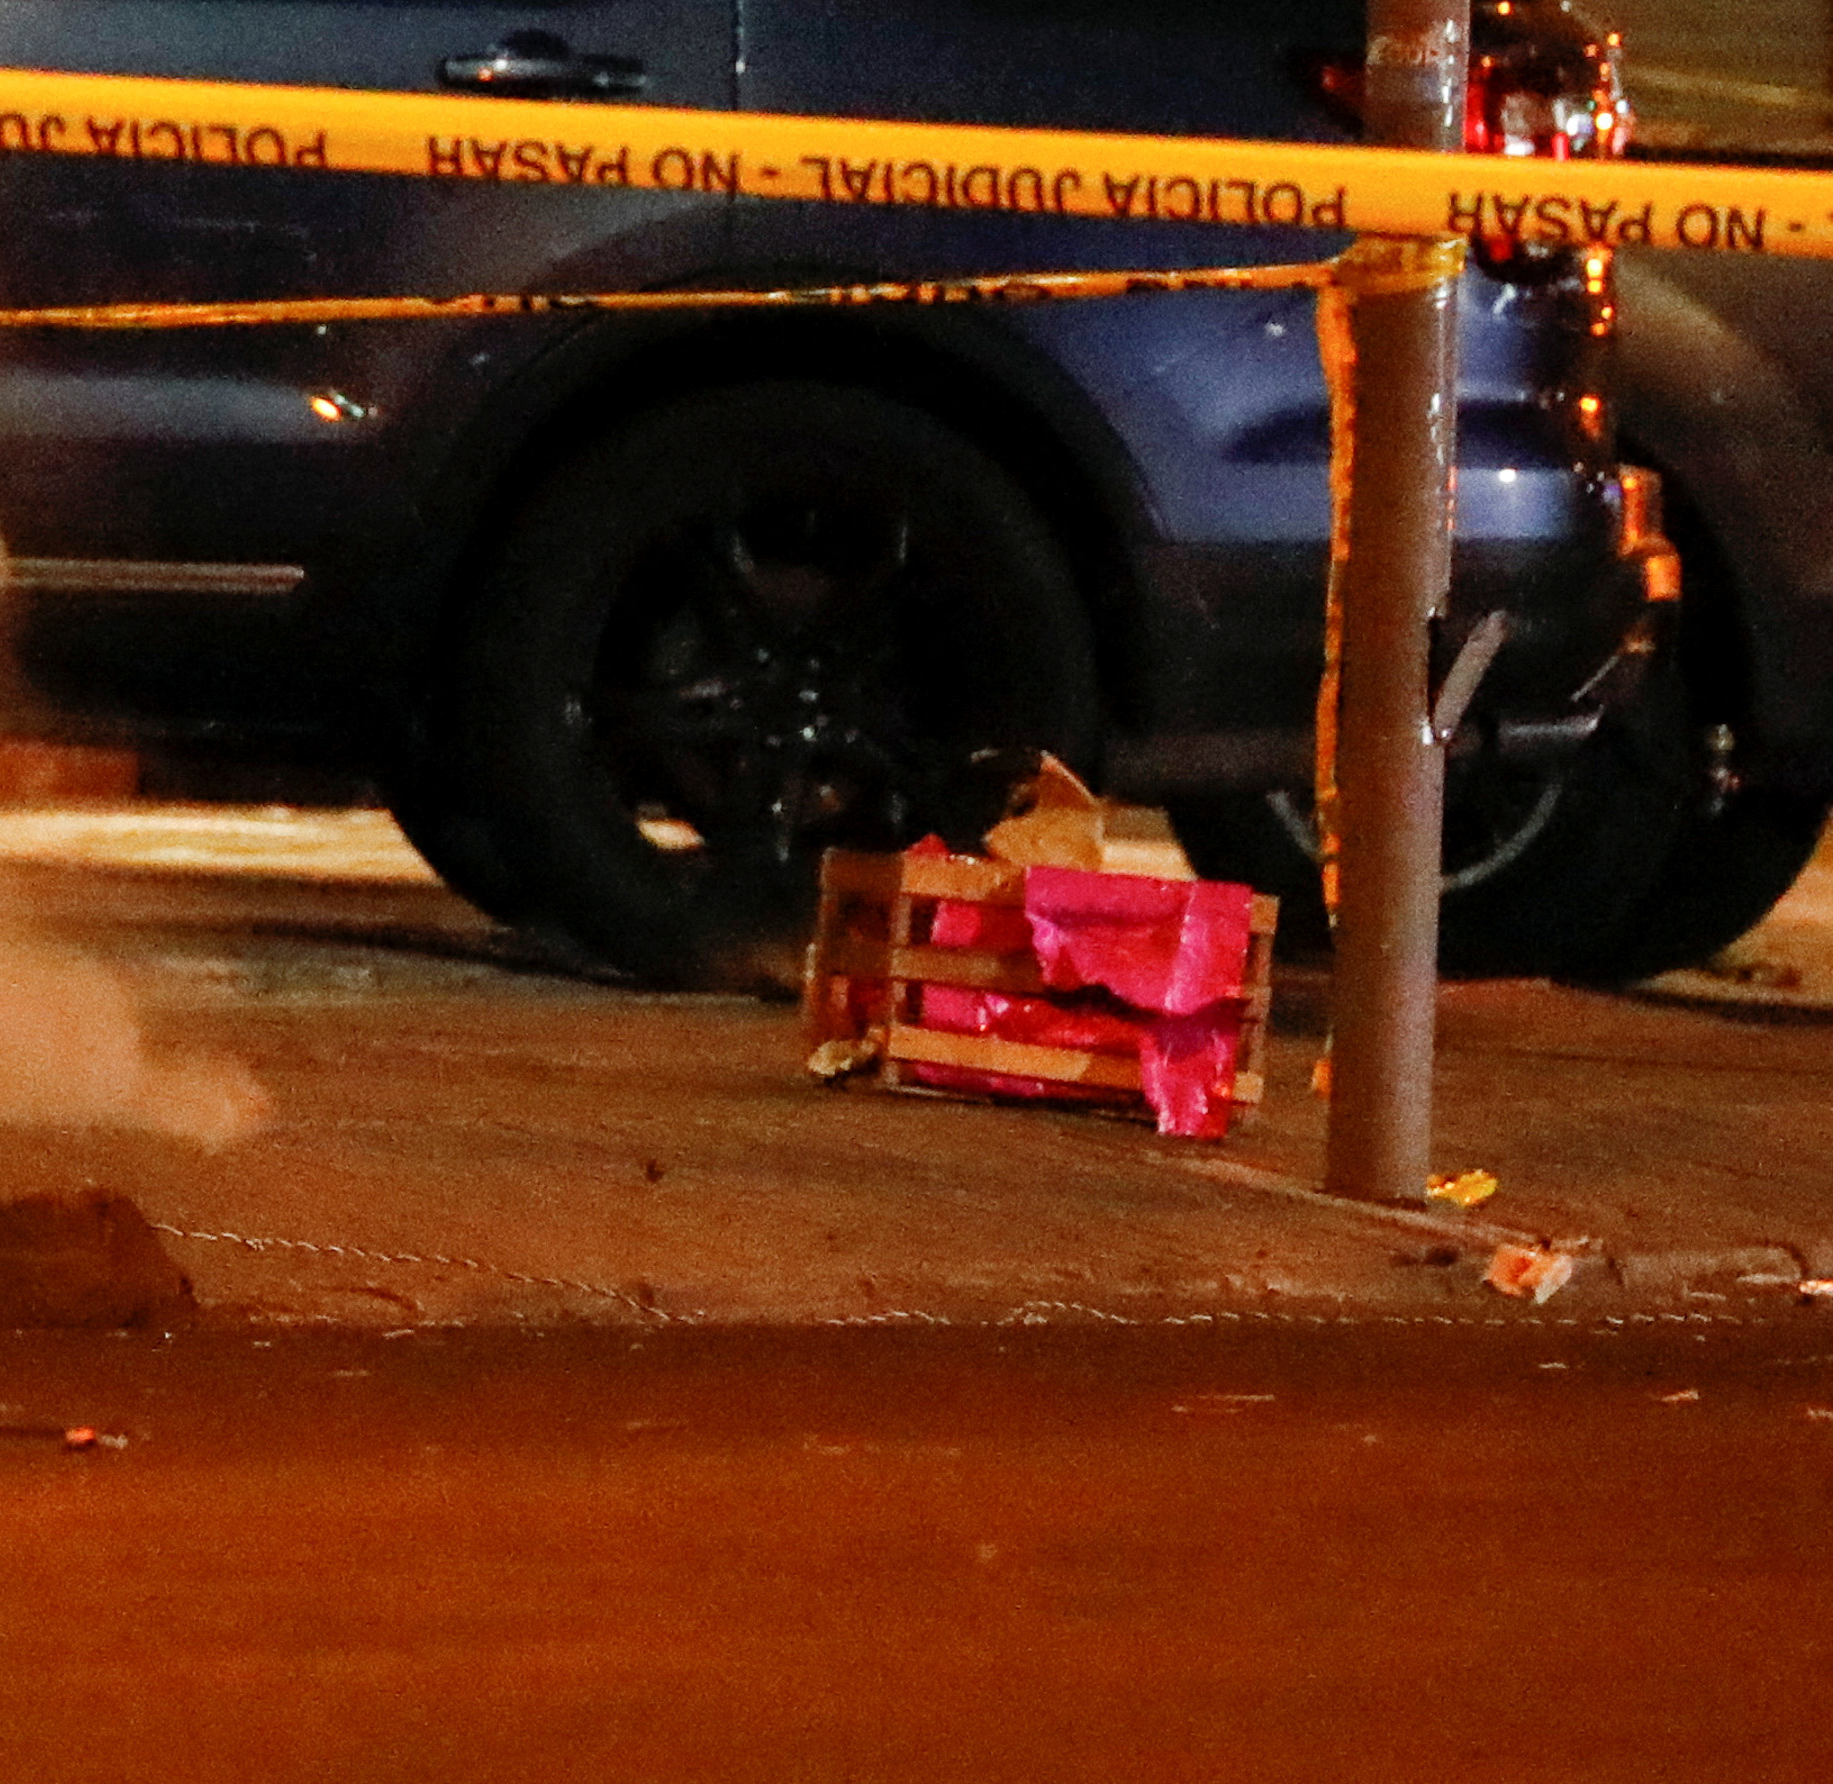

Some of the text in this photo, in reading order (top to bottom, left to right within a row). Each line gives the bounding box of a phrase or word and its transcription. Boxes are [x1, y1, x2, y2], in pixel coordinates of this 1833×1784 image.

[85, 118, 329, 168] POLICIA
[425, 135, 632, 186] PASAR
[652, 147, 744, 196] NO
[800, 156, 1084, 214] JUDICIAL
[1102, 173, 1348, 230] POLICIA
[1445, 192, 1656, 246] PASAR
[1675, 205, 1767, 252] NO
